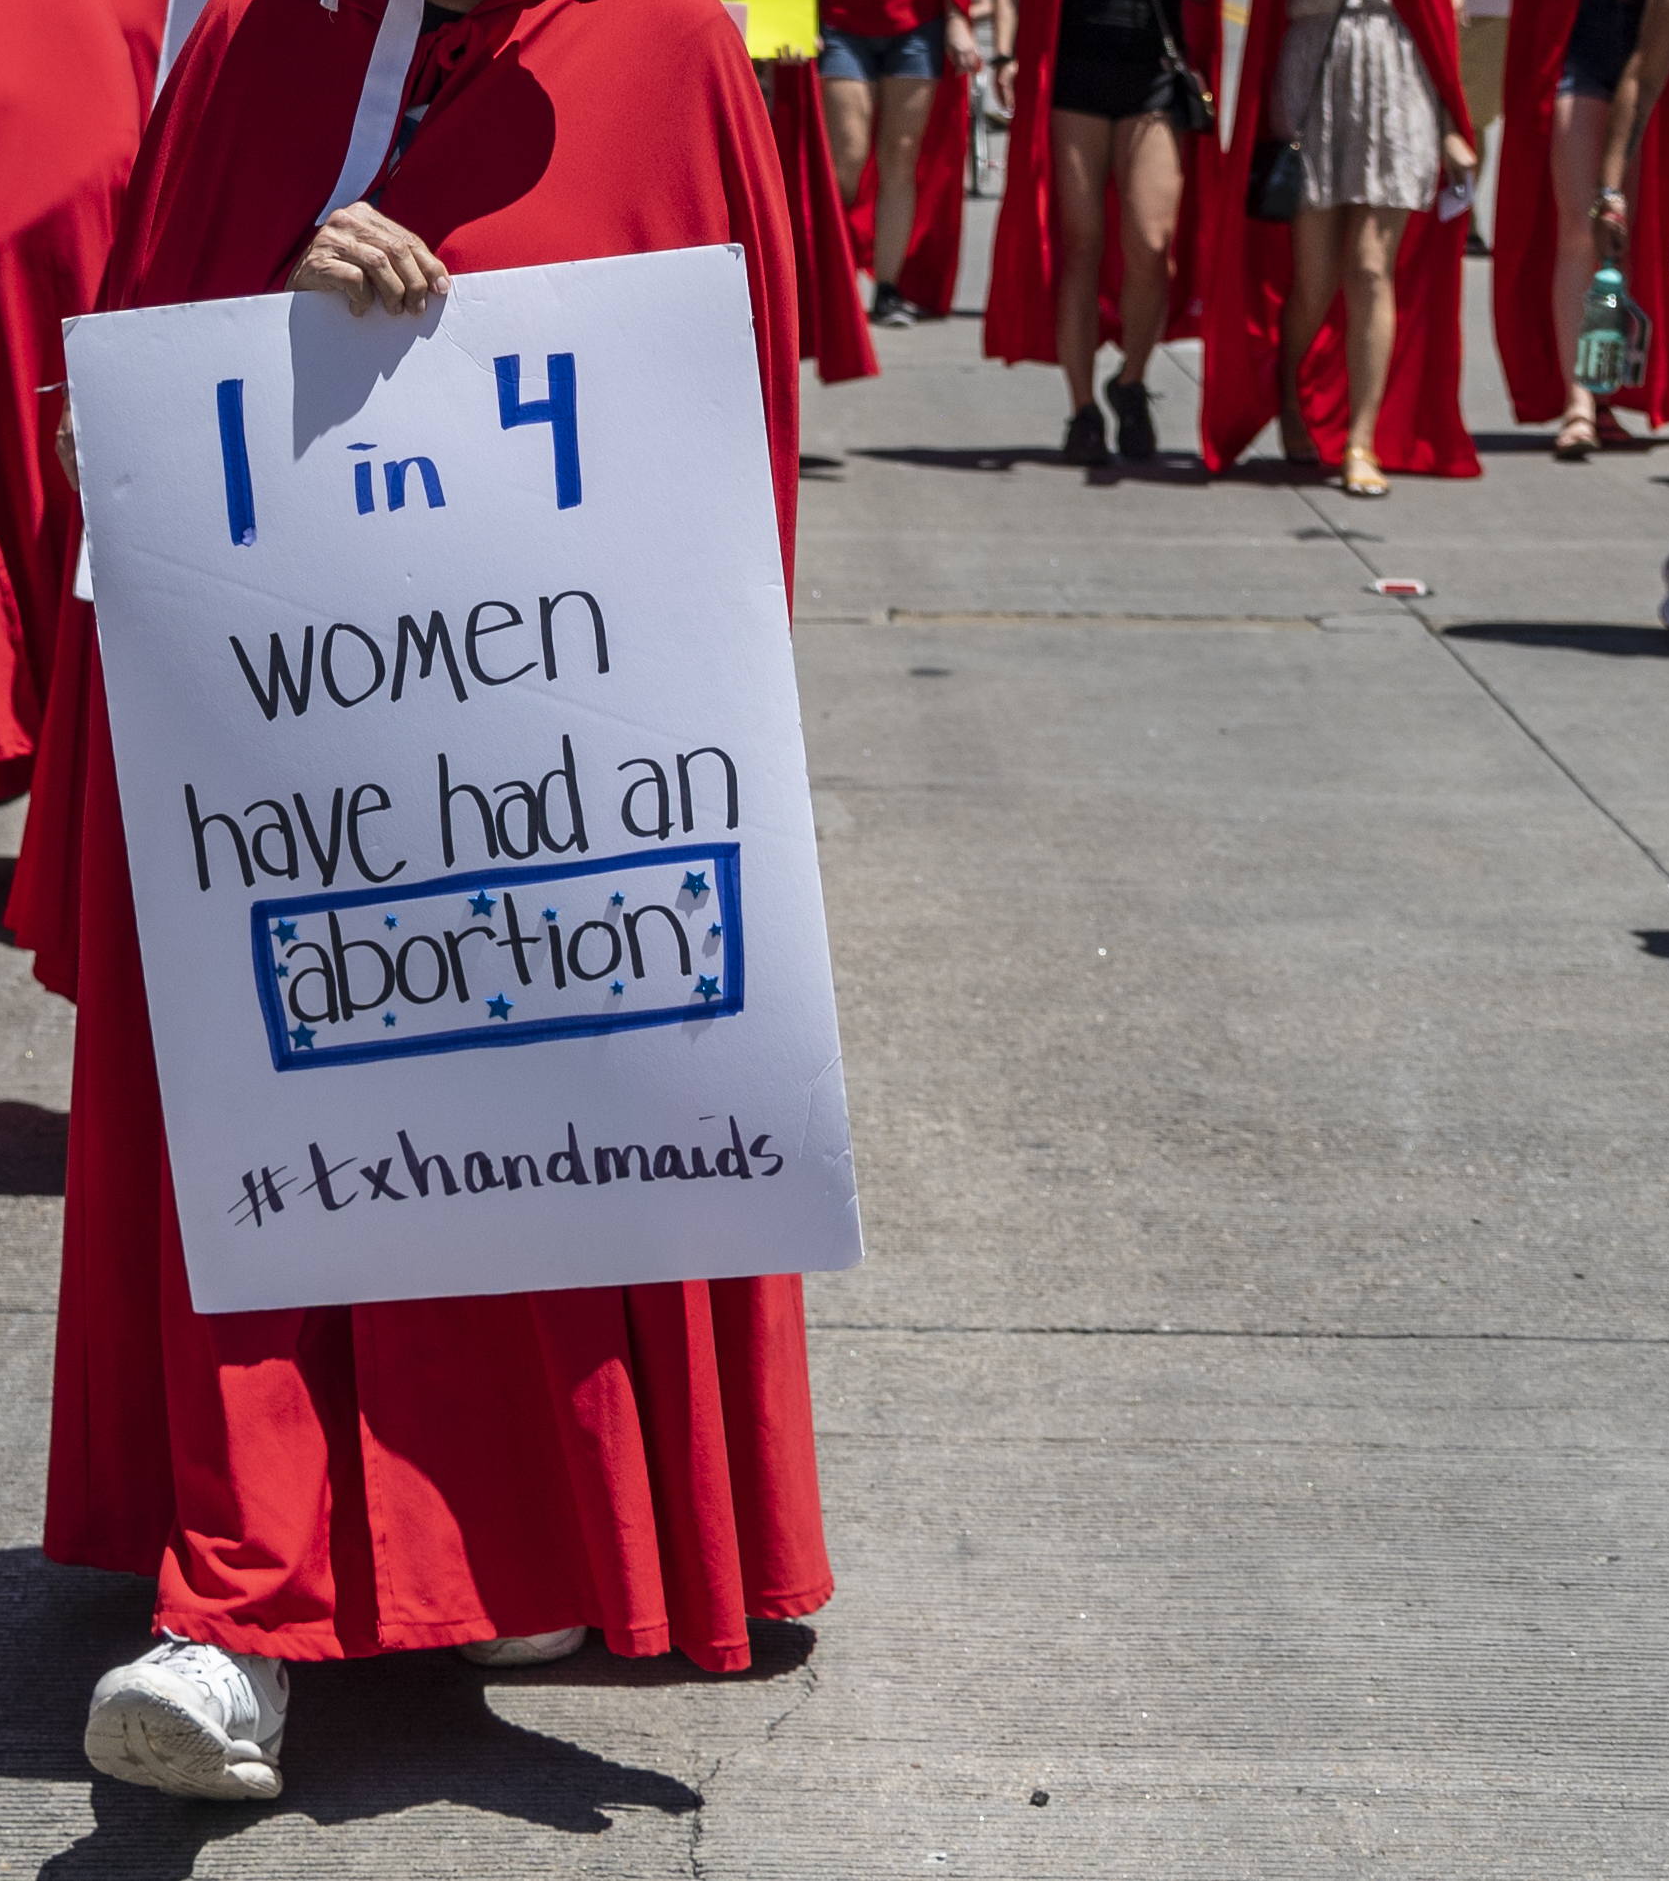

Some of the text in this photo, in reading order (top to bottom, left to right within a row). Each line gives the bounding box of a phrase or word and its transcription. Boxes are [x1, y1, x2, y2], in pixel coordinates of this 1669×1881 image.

[217, 352, 583, 547] 1 in 4
[185, 734, 740, 892] have had an
[286, 892, 693, 1025] abortion
[228, 1113, 784, 1227] #txhandmaids
